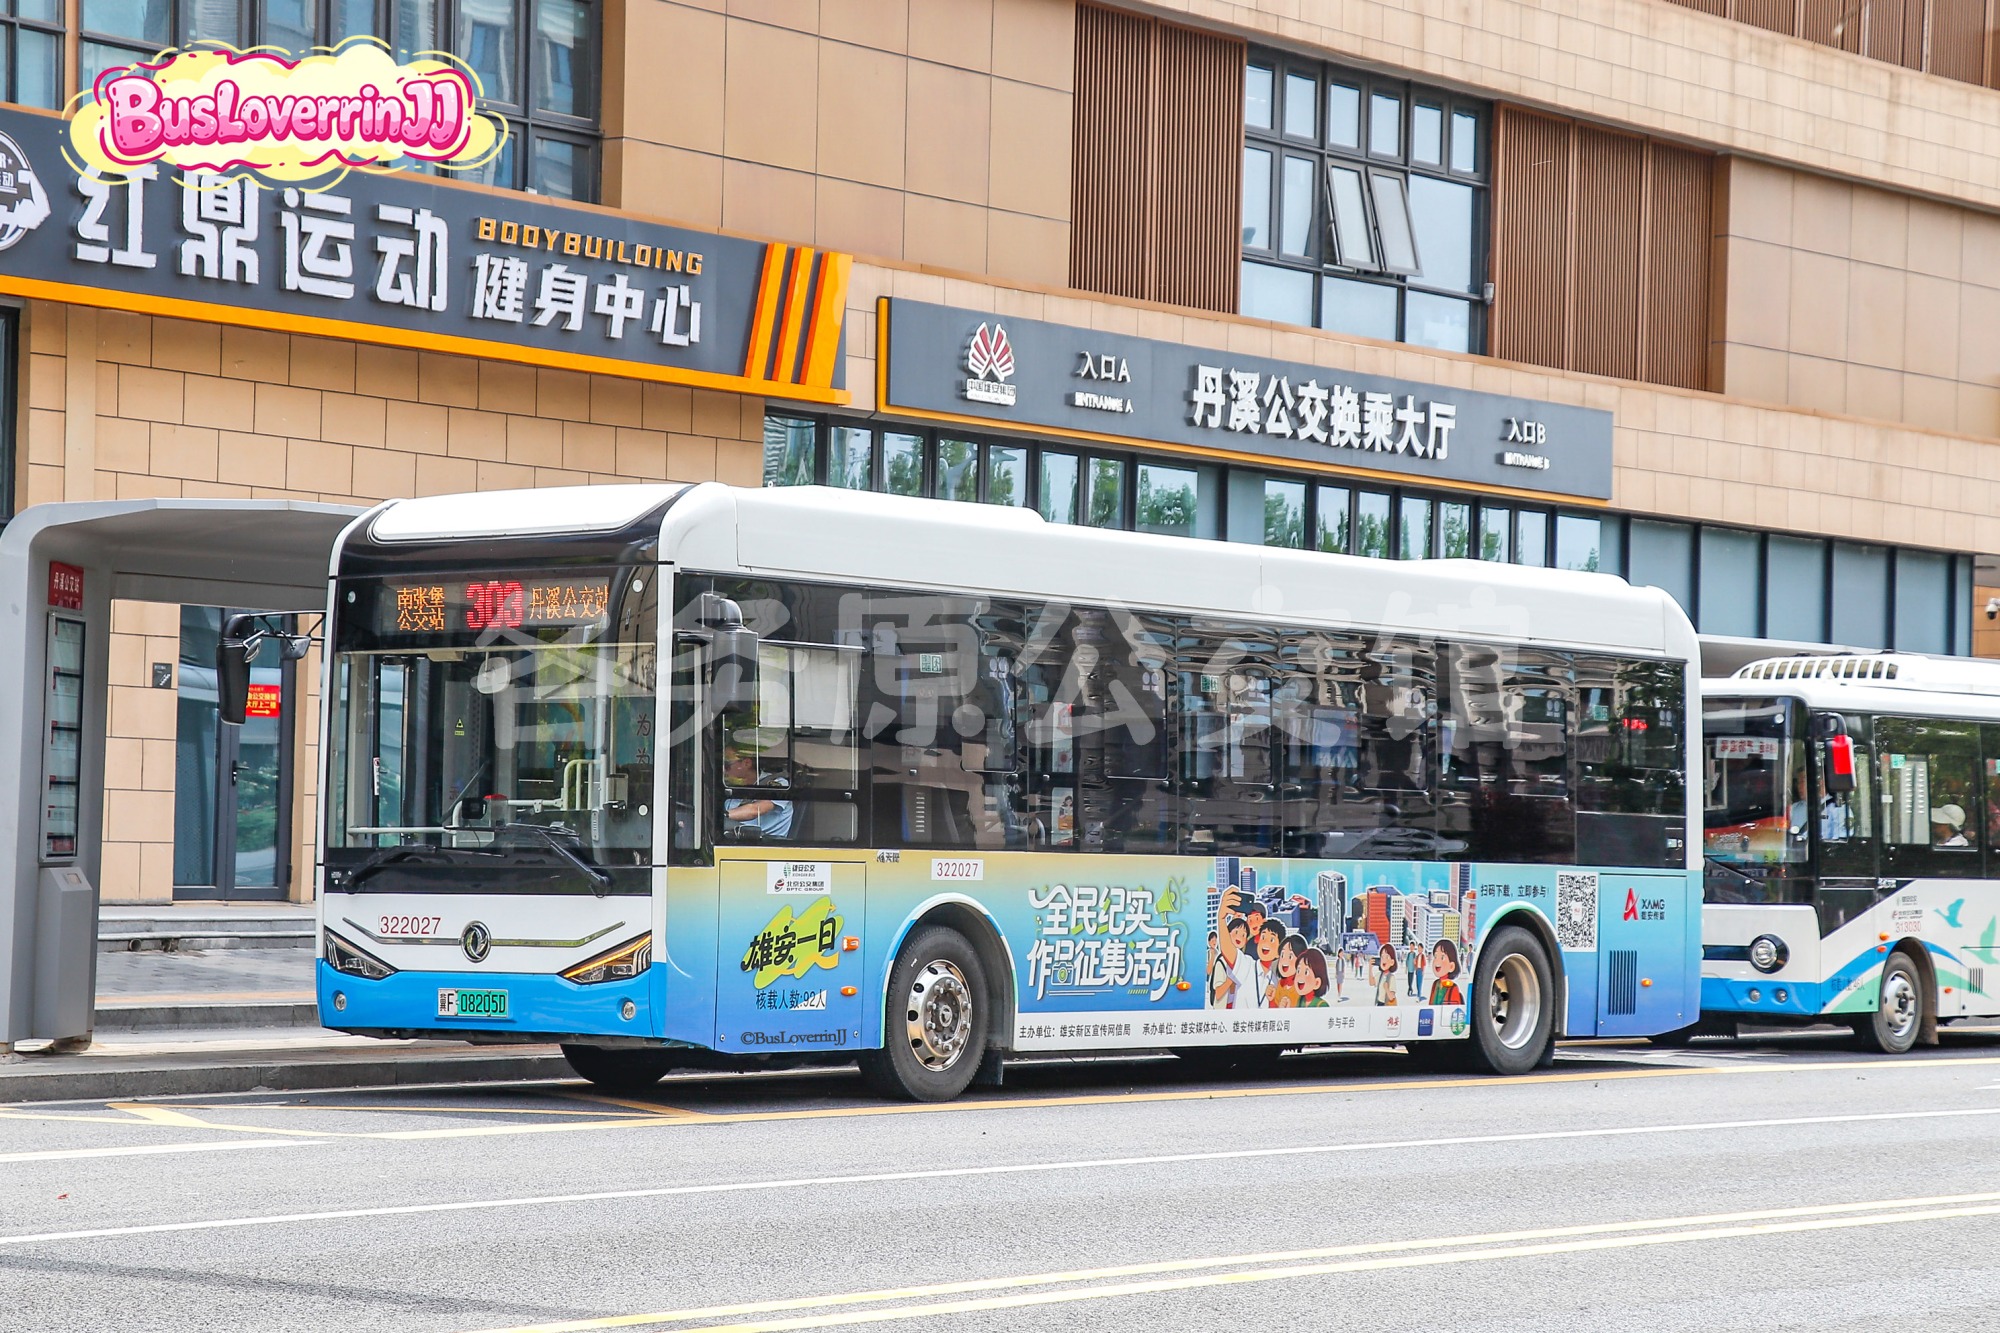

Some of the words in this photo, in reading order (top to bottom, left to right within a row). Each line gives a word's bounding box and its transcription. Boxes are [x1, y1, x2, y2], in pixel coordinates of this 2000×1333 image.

[478, 217, 703, 275] BODYBUILDING
[472, 253, 701, 346] 健身中心
[1193, 364, 1456, 460] 丹溪公交换乘大厅
[397, 586, 445, 609] 南张堡
[397, 608, 445, 631] 公交站
[466, 581, 523, 628] 303
[529, 585, 609, 620] 丹溪公交站
[937, 862, 979, 877] 322027
[380, 916, 441, 934] 322027
[1028, 884, 1169, 936] 全民纪实
[740, 917, 836, 971] 雄安一日
[1027, 929, 1180, 1002] 作品征集活动
